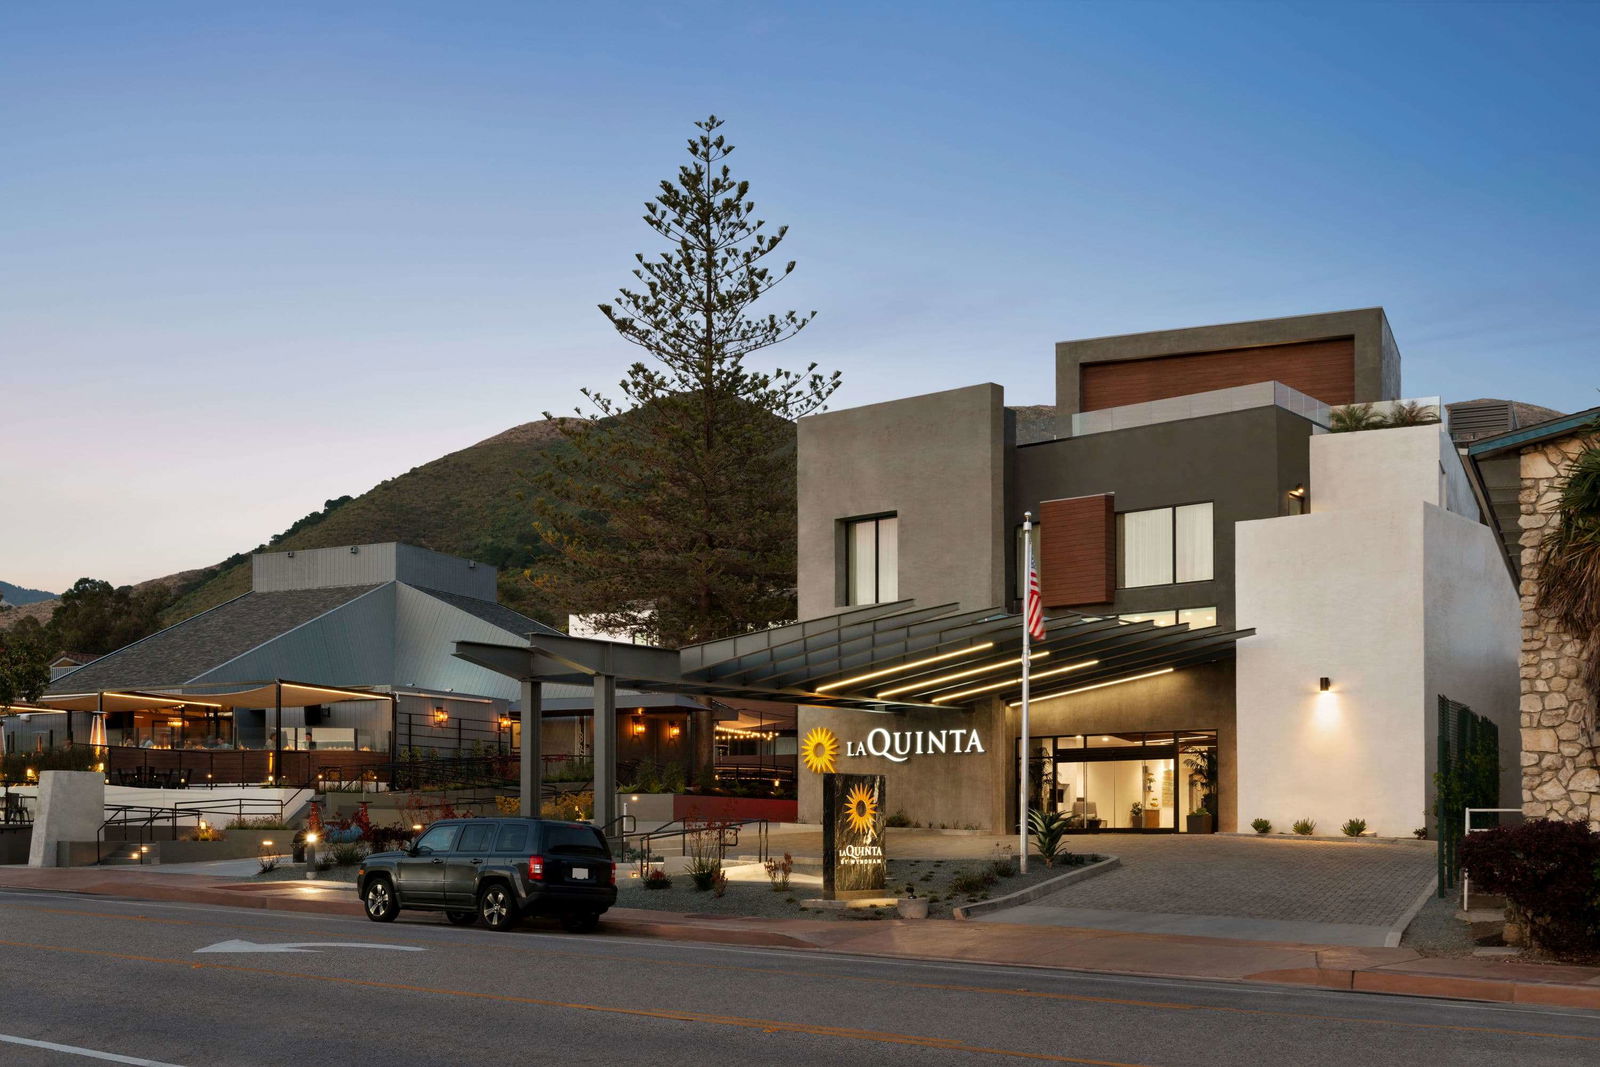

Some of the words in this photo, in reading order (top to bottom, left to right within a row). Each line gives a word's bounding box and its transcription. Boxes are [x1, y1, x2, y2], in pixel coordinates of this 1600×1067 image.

[847, 741, 867, 756] LA
[867, 728, 984, 762] QUINTA
[846, 845, 882, 859] QUINTA
